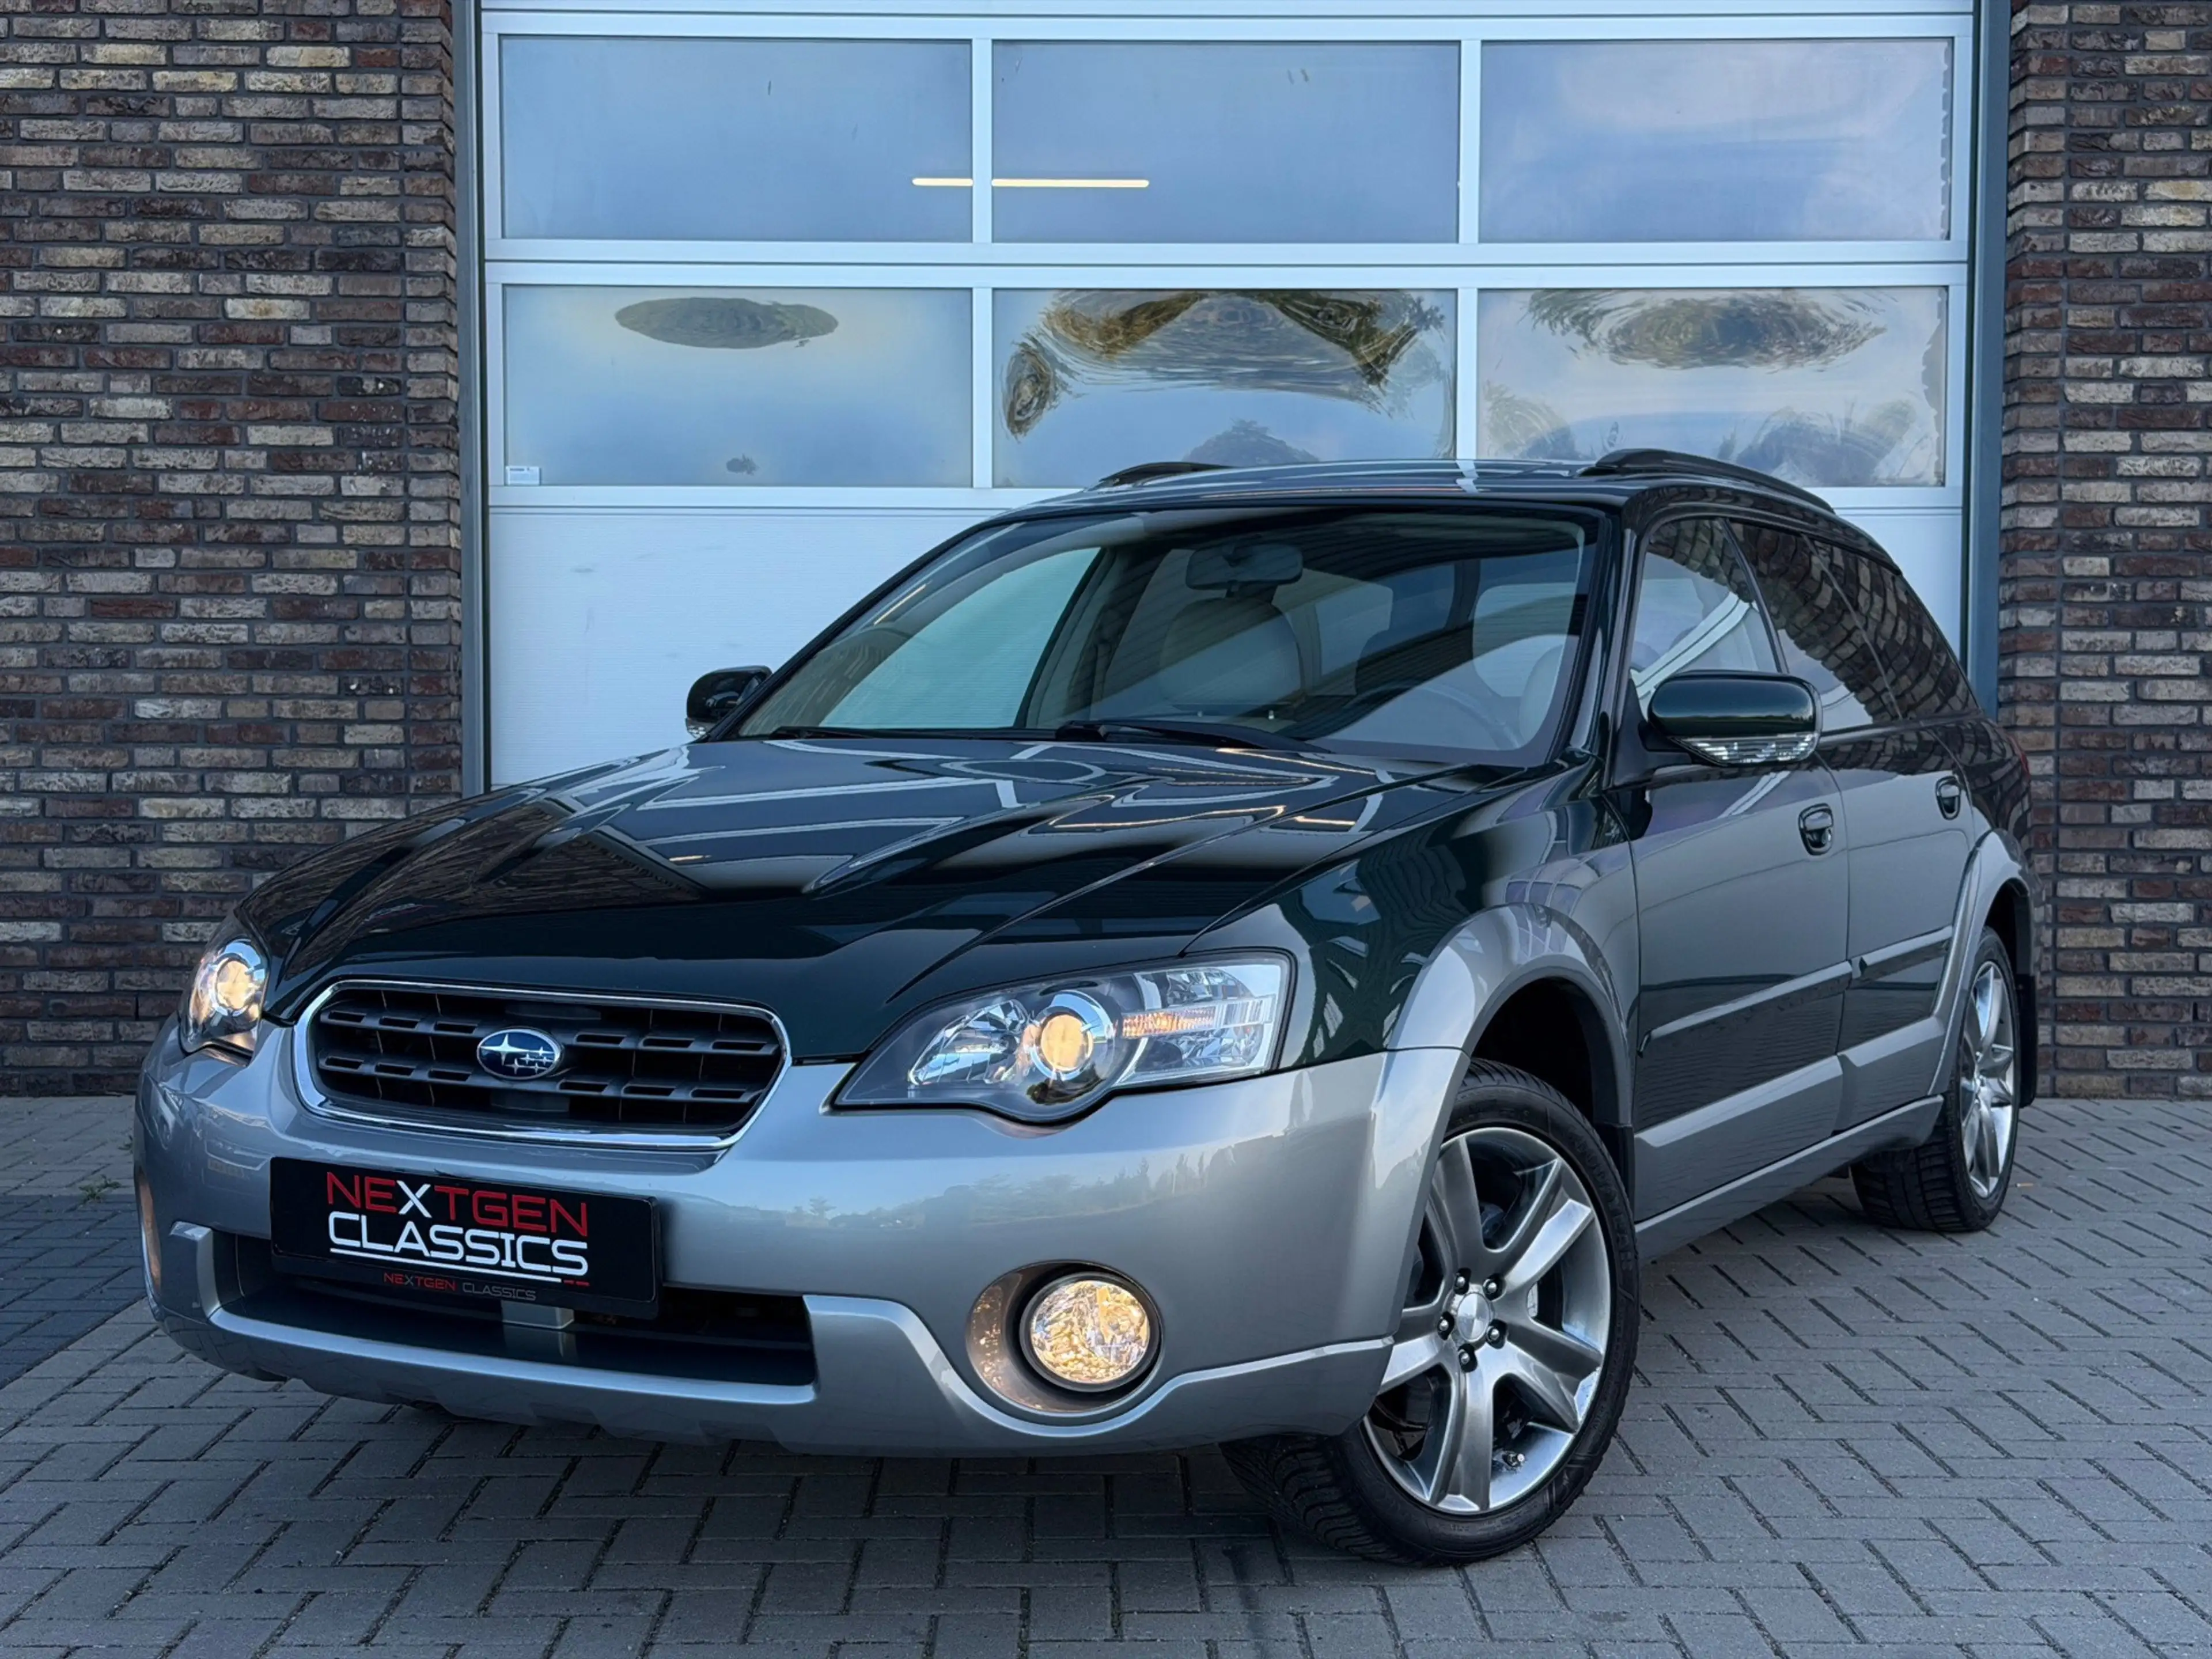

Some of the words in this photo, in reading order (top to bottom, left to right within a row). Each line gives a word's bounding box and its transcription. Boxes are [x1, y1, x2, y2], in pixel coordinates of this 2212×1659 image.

[327, 1171, 588, 1237] NEXTGEN
[328, 1211, 589, 1277] CLASSICS
[384, 1272, 456, 1291] NEXTGEN
[463, 1282, 536, 1301] CLASSICS
